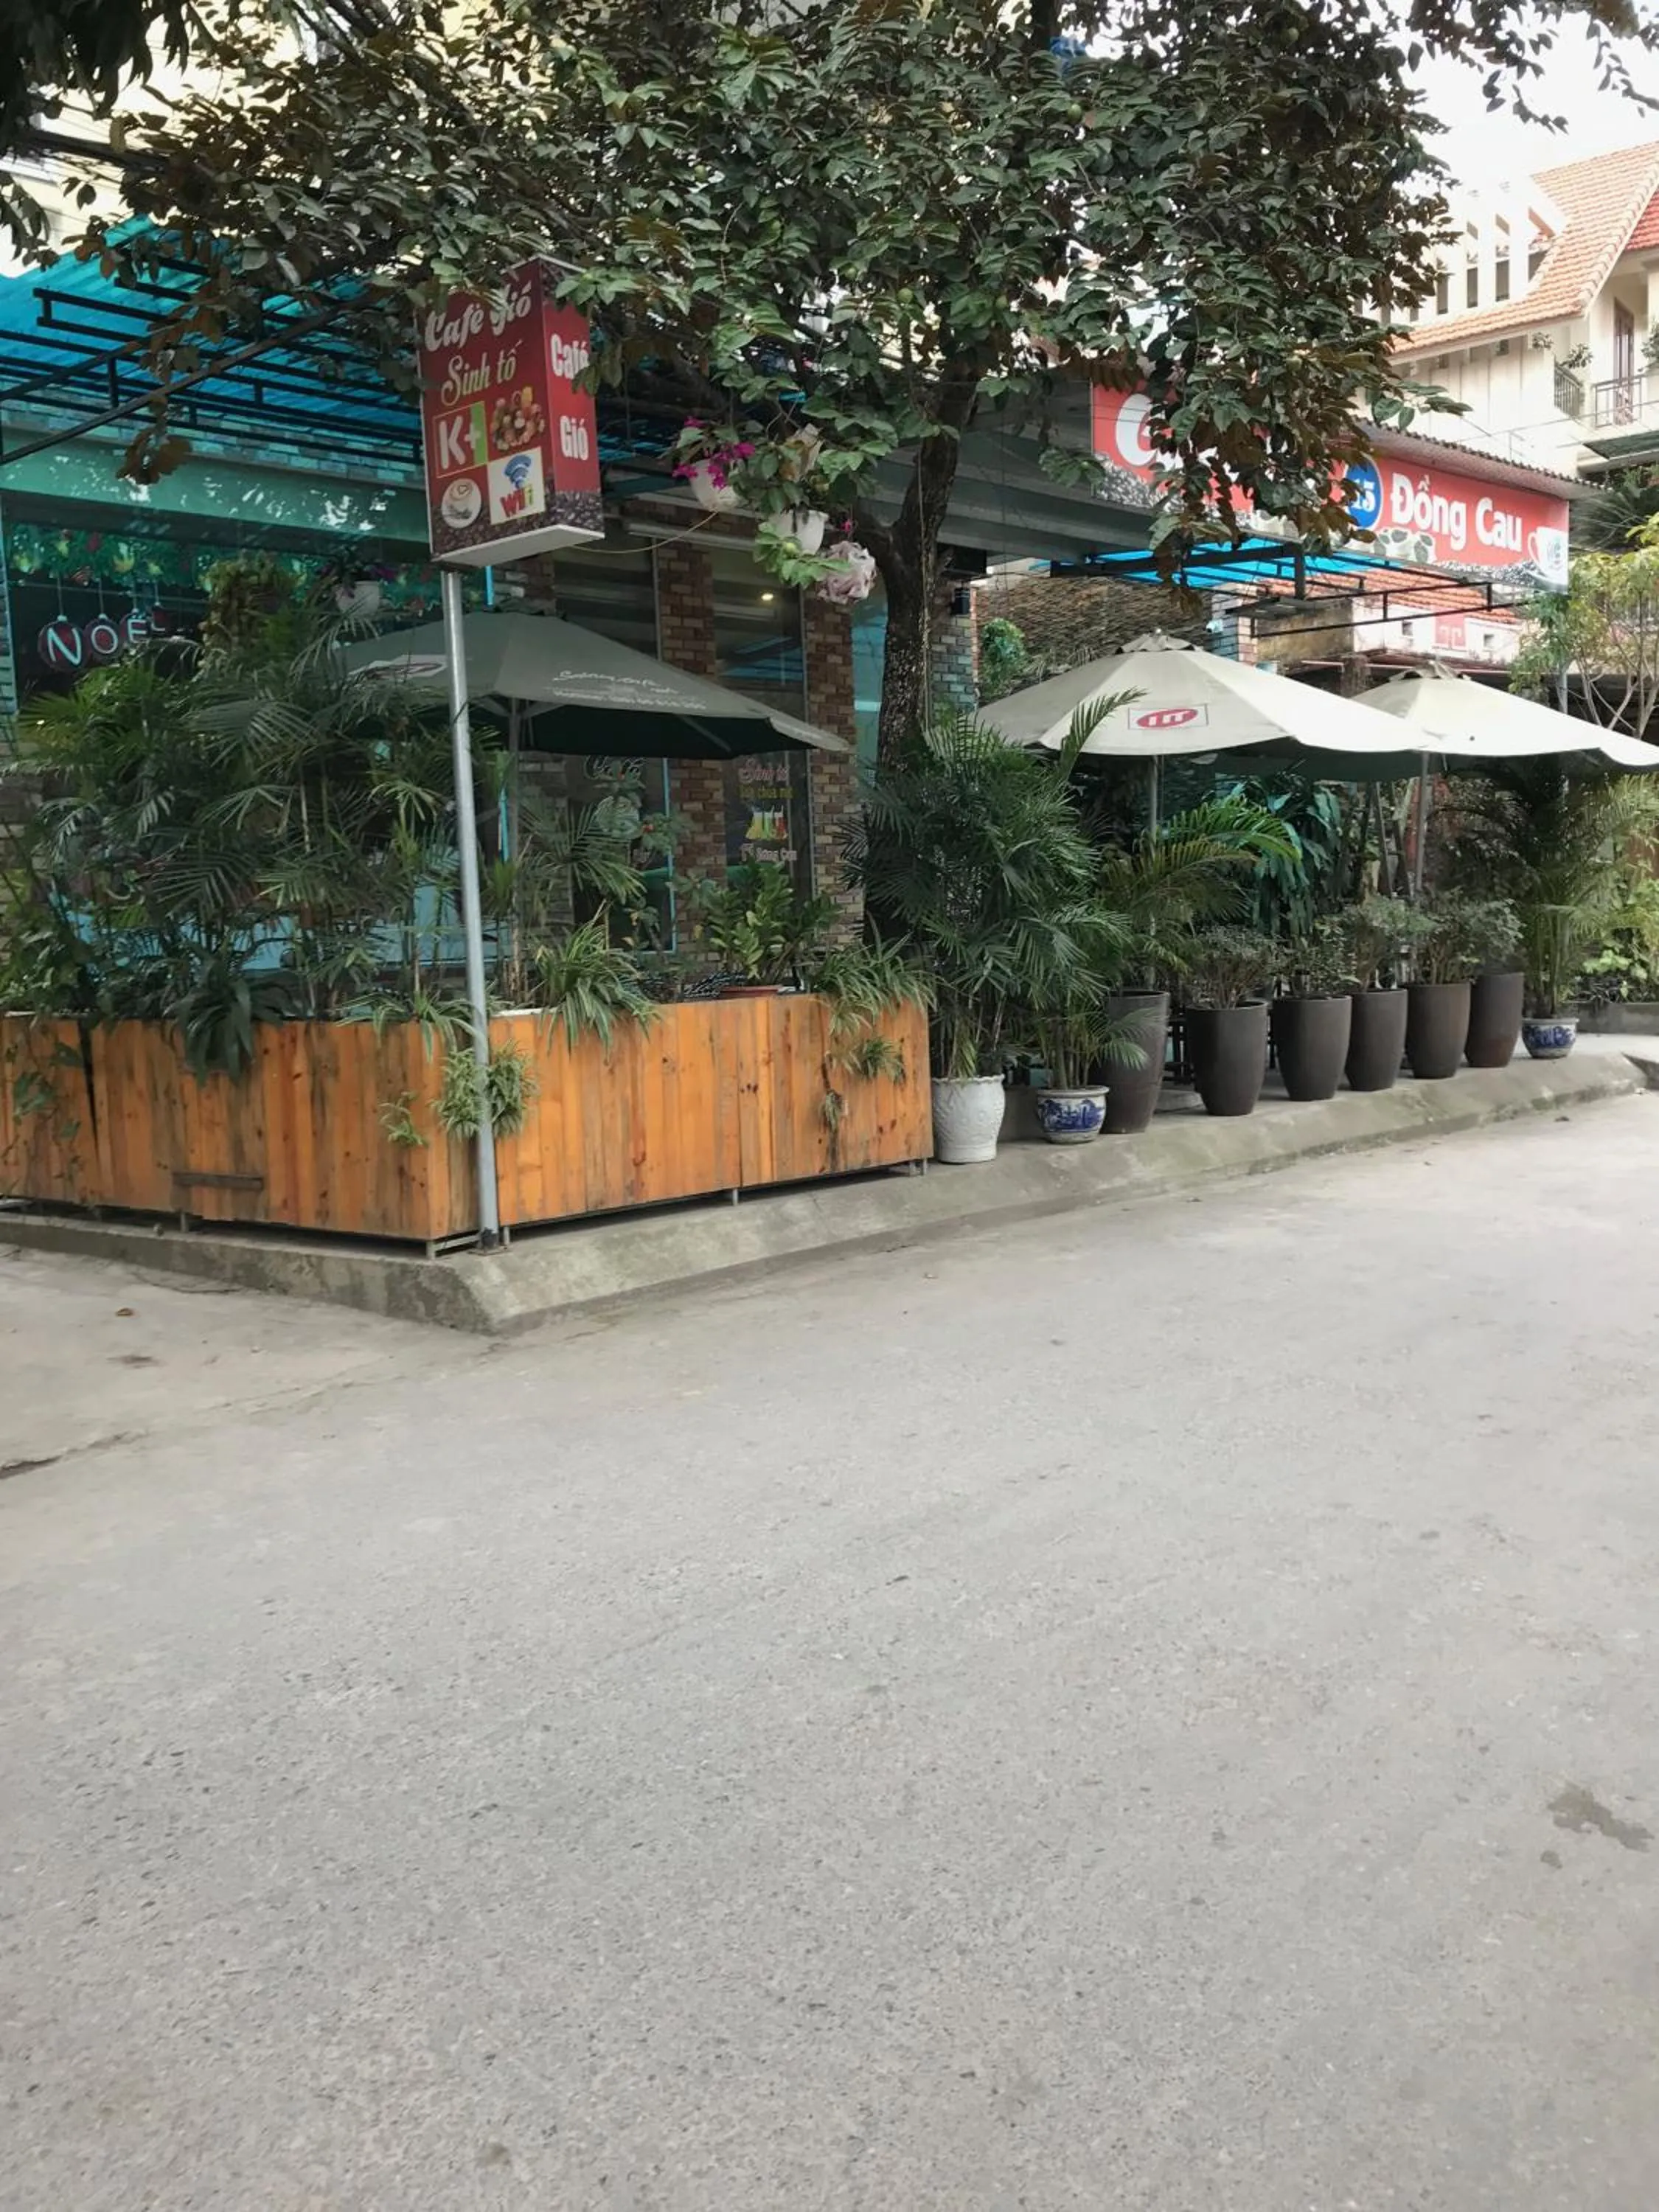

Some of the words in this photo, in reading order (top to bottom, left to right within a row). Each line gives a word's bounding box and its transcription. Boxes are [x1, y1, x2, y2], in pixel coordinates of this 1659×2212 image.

[441, 352, 491, 406] Sinh
[496, 338, 524, 384] tố
[439, 415, 481, 470] K+
[560, 415, 589, 461] Gió
[1391, 472, 1467, 552] Đồng
[1475, 497, 1523, 552] Cau
